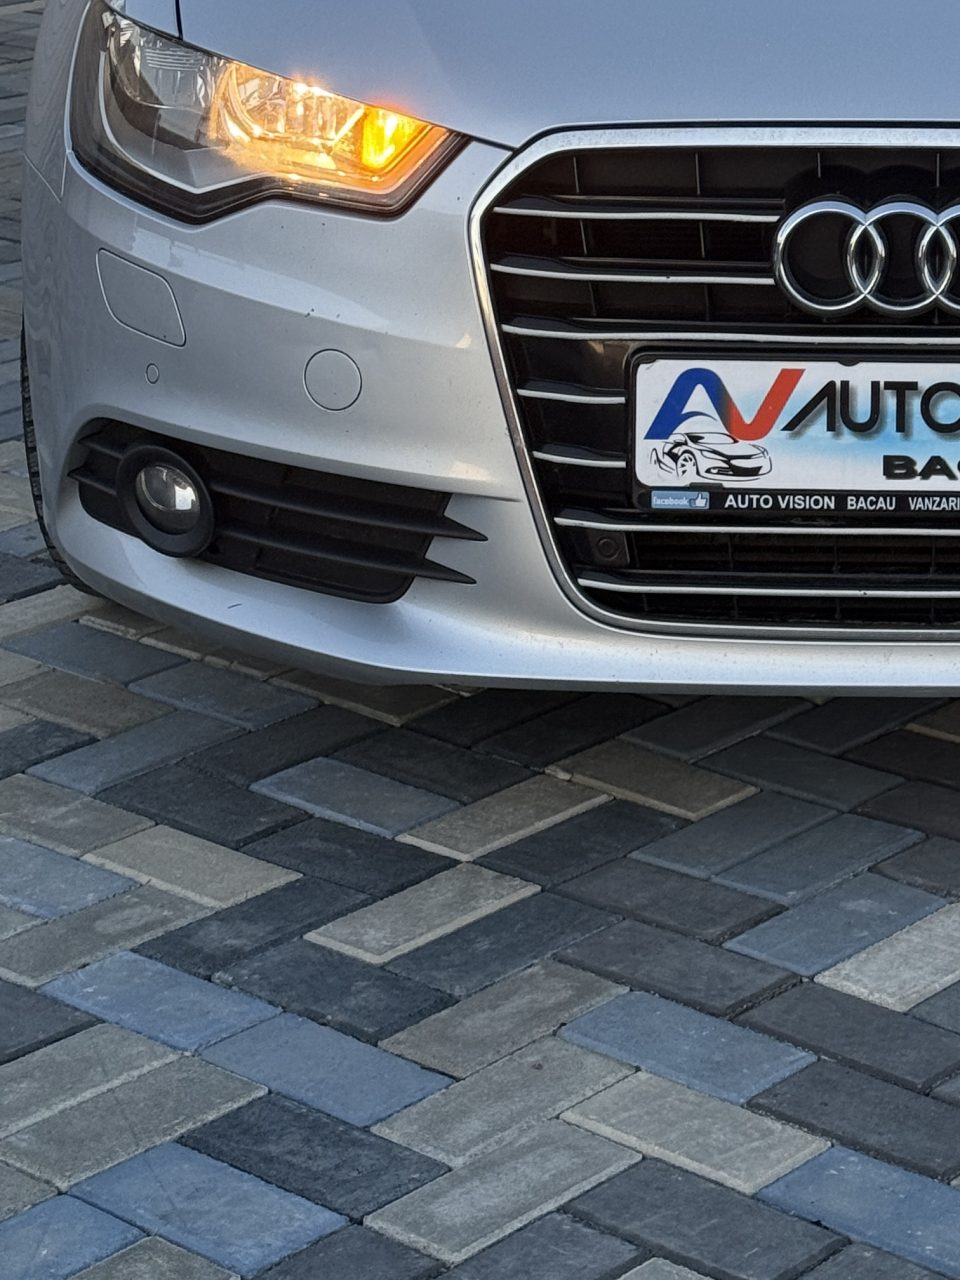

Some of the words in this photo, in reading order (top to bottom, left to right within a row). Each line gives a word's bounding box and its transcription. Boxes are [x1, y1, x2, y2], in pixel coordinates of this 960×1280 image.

[724, 494, 773, 509] AUTO
[777, 495, 835, 510] VISION
[847, 496, 896, 510] BACAU
[908, 496, 960, 511] VANZARI
